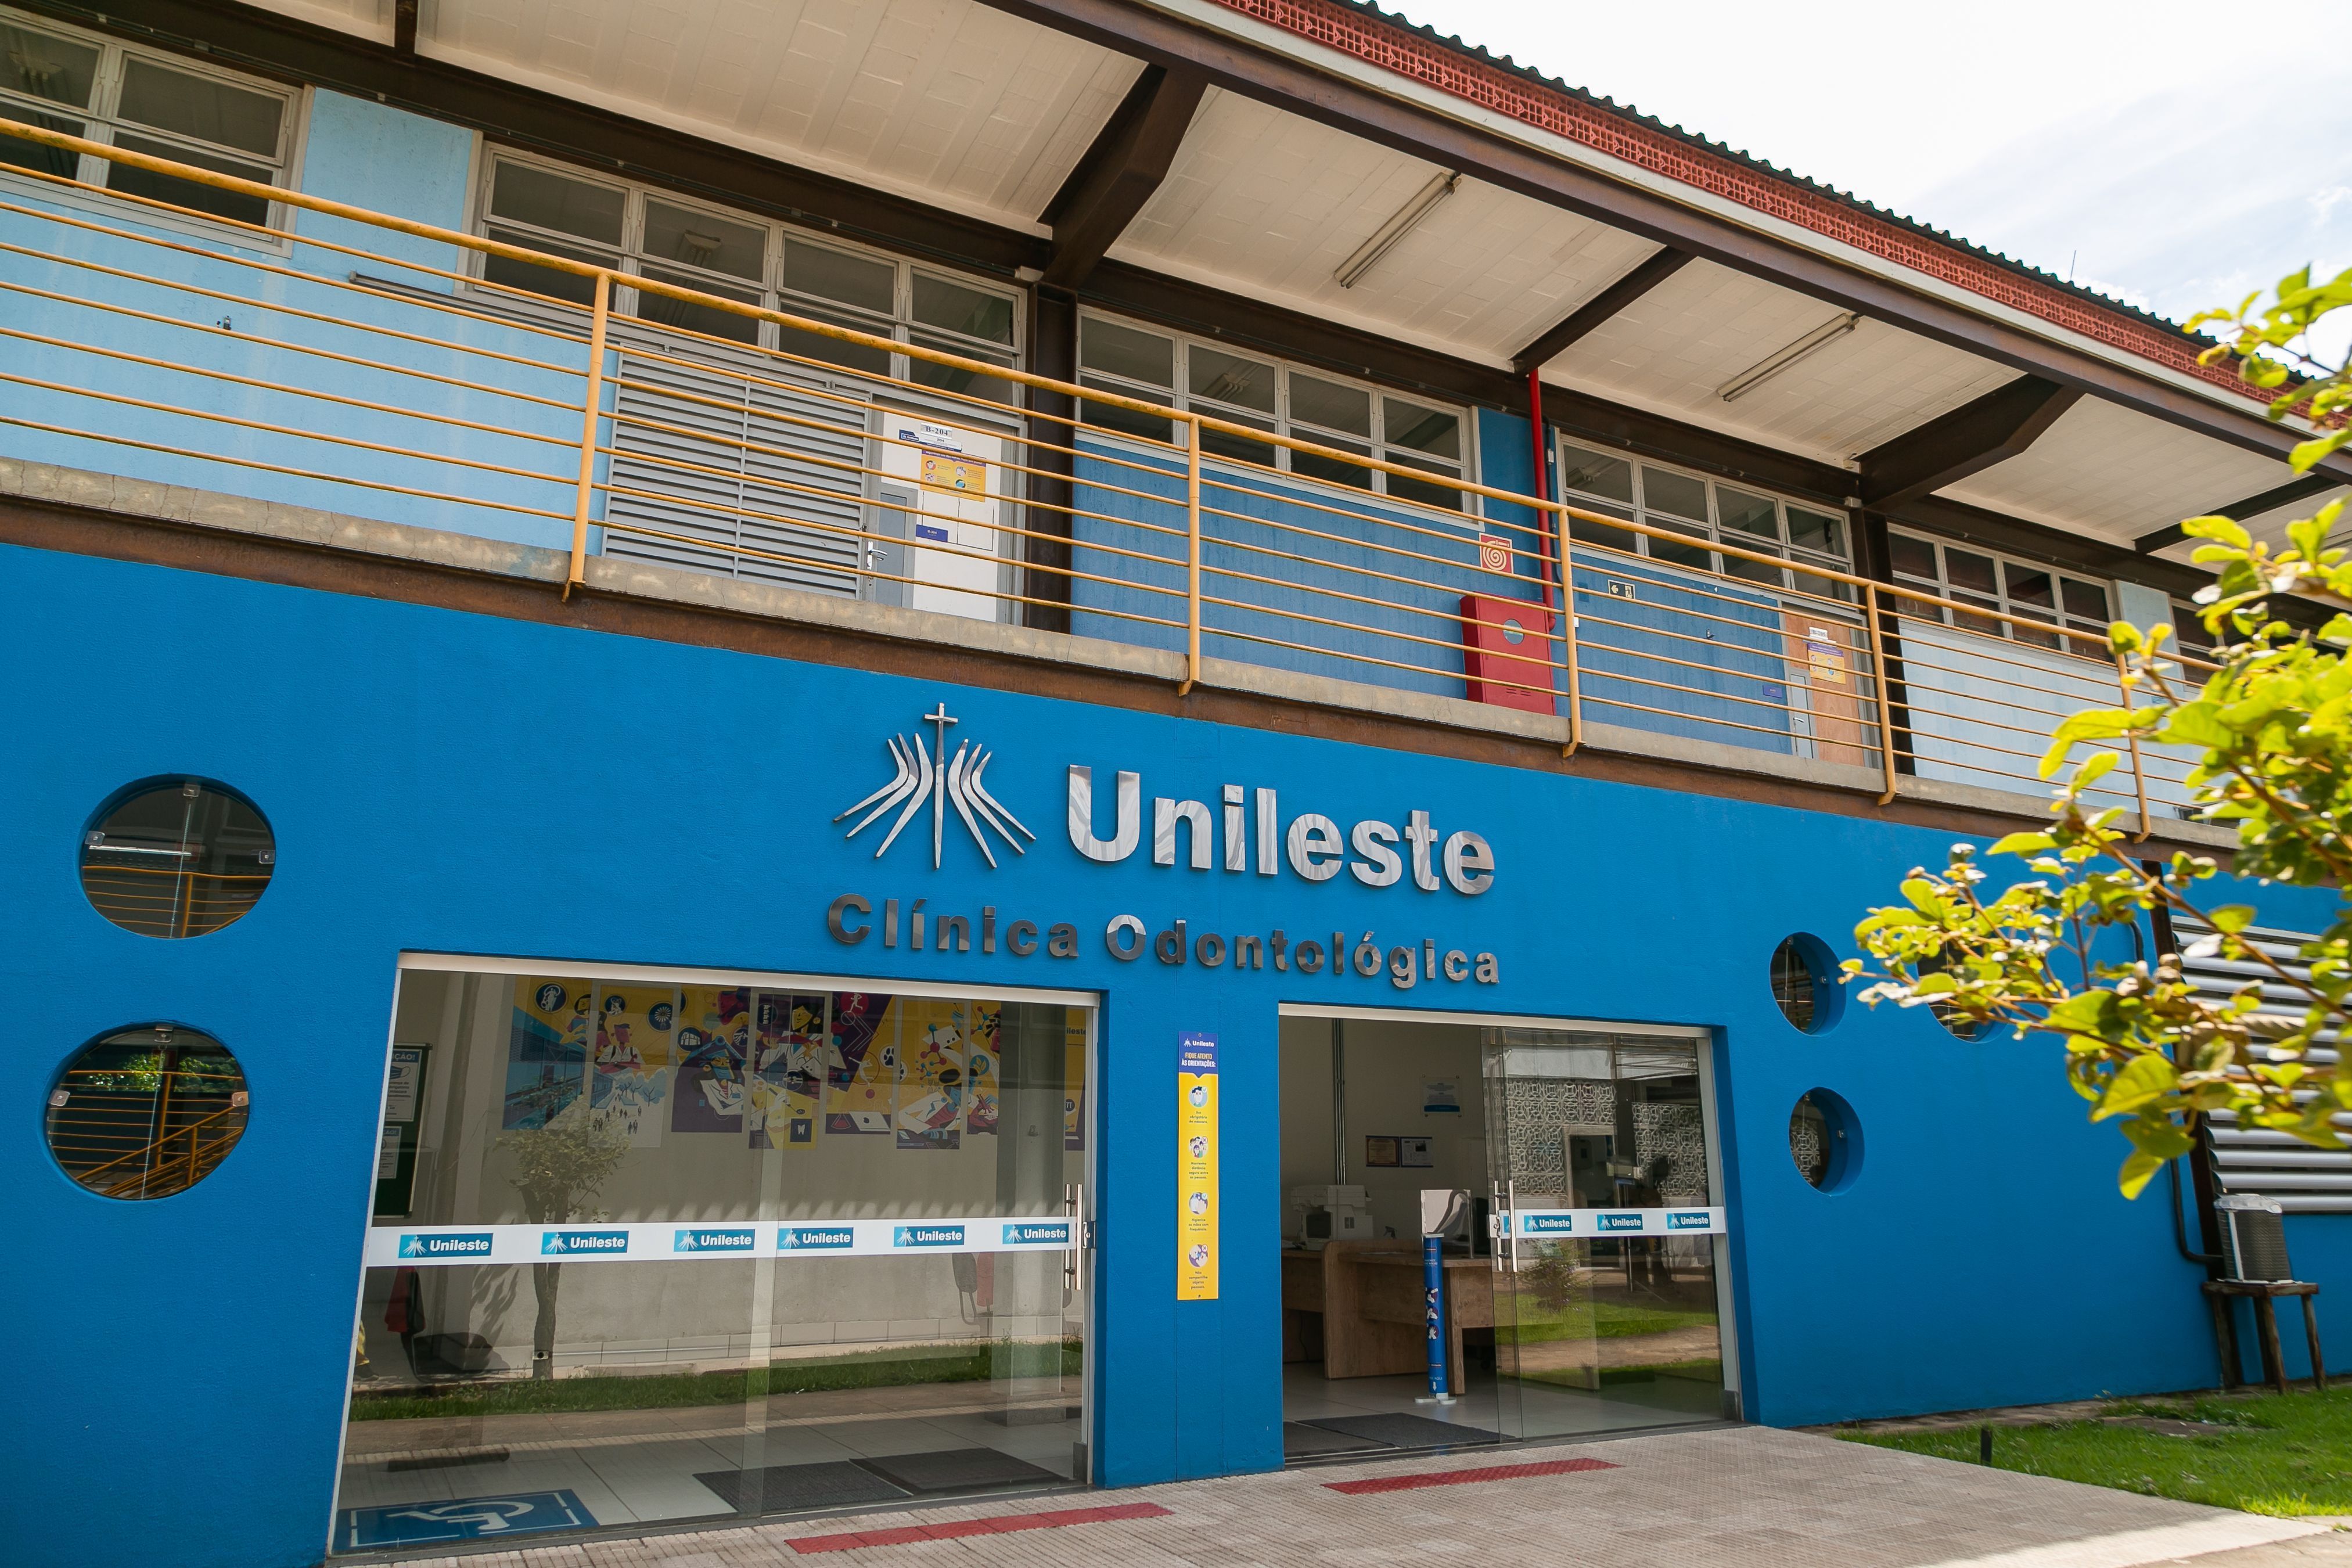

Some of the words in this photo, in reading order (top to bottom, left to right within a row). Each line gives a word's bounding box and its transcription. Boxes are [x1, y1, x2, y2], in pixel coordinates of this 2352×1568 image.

[925, 426, 948, 436] B-204
[1066, 764, 1495, 896] Unileste
[828, 893, 1078, 957] Clínica
[1106, 914, 1499, 988] Odontológica
[1181, 1058, 1187, 1066] ÀS
[1188, 1059, 1216, 1068] ORIENTAÇÕES:
[1539, 1218, 1570, 1228] Unileste
[1612, 1217, 1642, 1227] Unileste
[1681, 1215, 1709, 1226] Unileste
[802, 1232, 851, 1245] Unileste
[916, 1231, 962, 1242] Unileste
[1024, 1228, 1067, 1240] Unileste
[429, 1239, 489, 1252] Unileste
[570, 1236, 625, 1249] Unileste
[700, 1235, 752, 1246] Unileste
